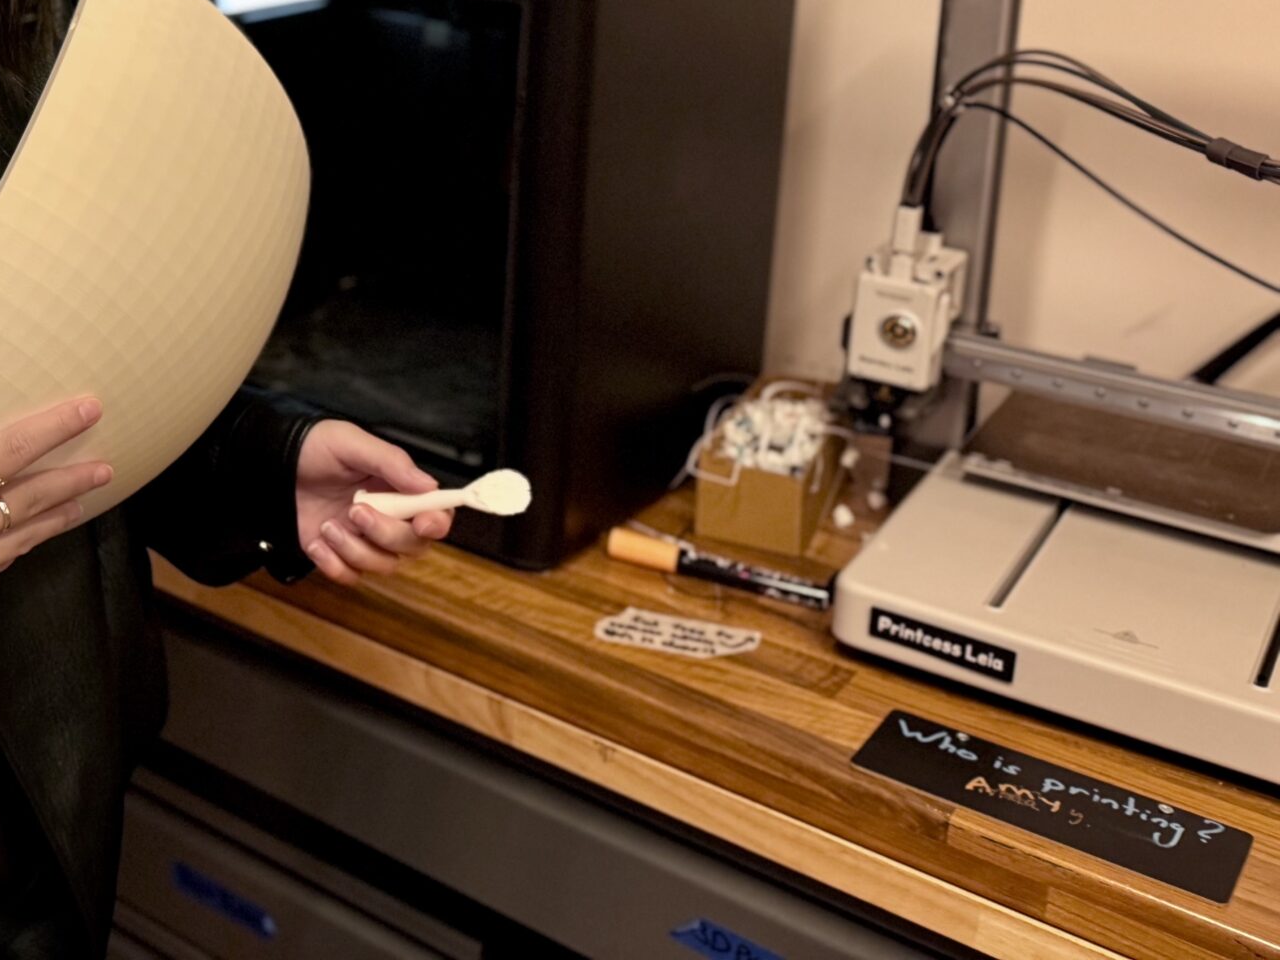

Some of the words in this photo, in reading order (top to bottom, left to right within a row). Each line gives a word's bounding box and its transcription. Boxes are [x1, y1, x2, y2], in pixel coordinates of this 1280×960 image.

[876, 614, 963, 658] Printcess
[965, 643, 1005, 672] Leia
[897, 717, 979, 763] Who
[992, 754, 1023, 777] is
